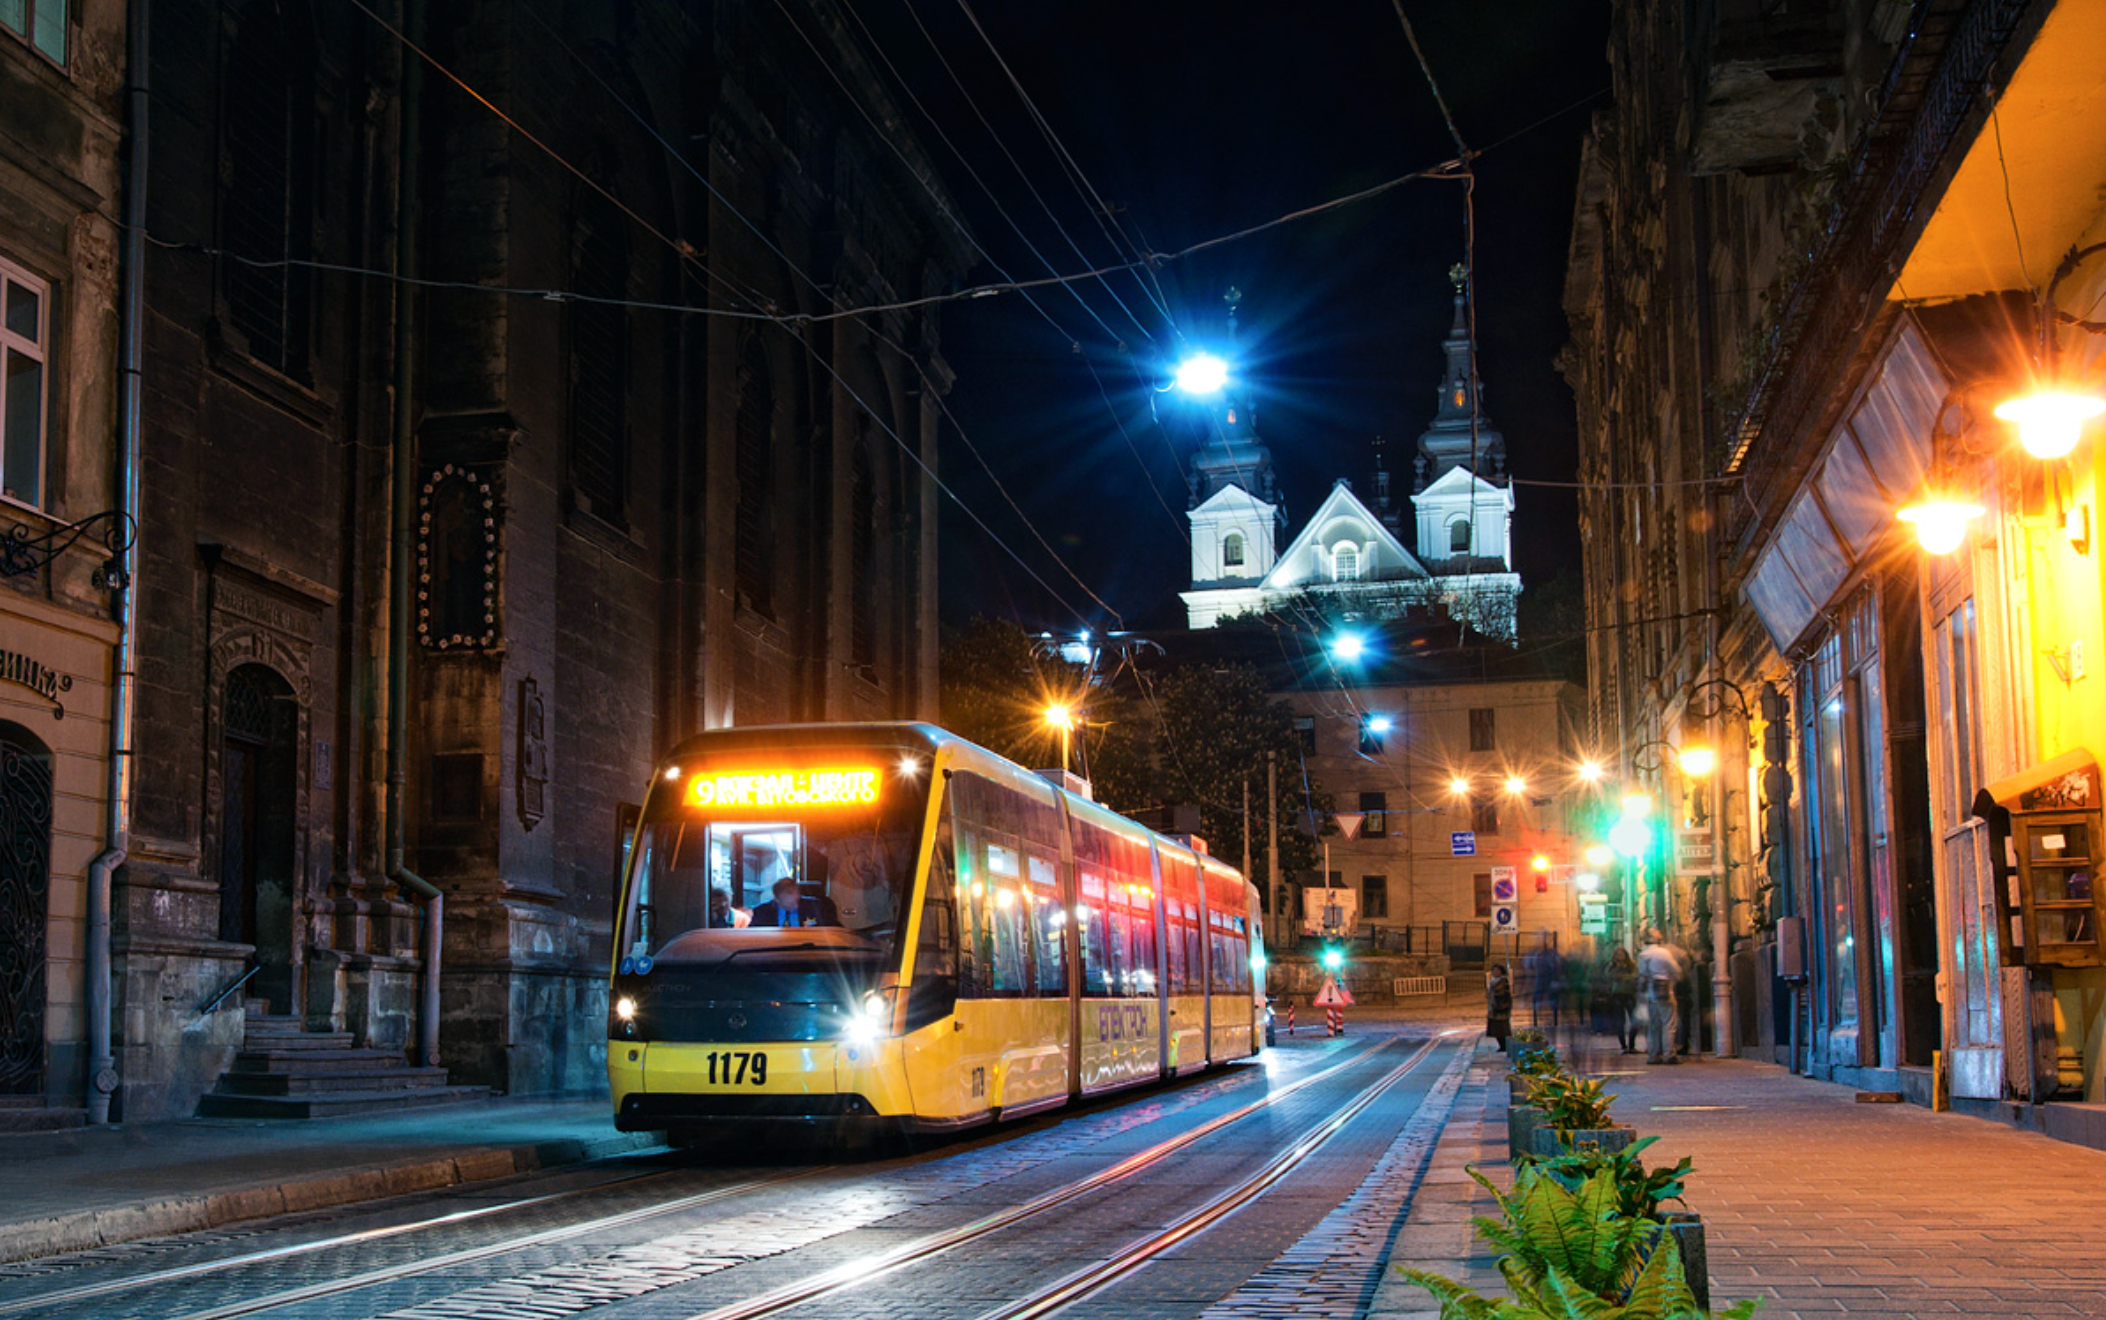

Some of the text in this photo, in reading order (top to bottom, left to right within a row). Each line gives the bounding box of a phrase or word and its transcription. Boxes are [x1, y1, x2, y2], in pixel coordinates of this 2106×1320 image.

[696, 780, 715, 804] 9
[810, 771, 875, 790] ЦЕНТР
[707, 1052, 768, 1086] 1179
